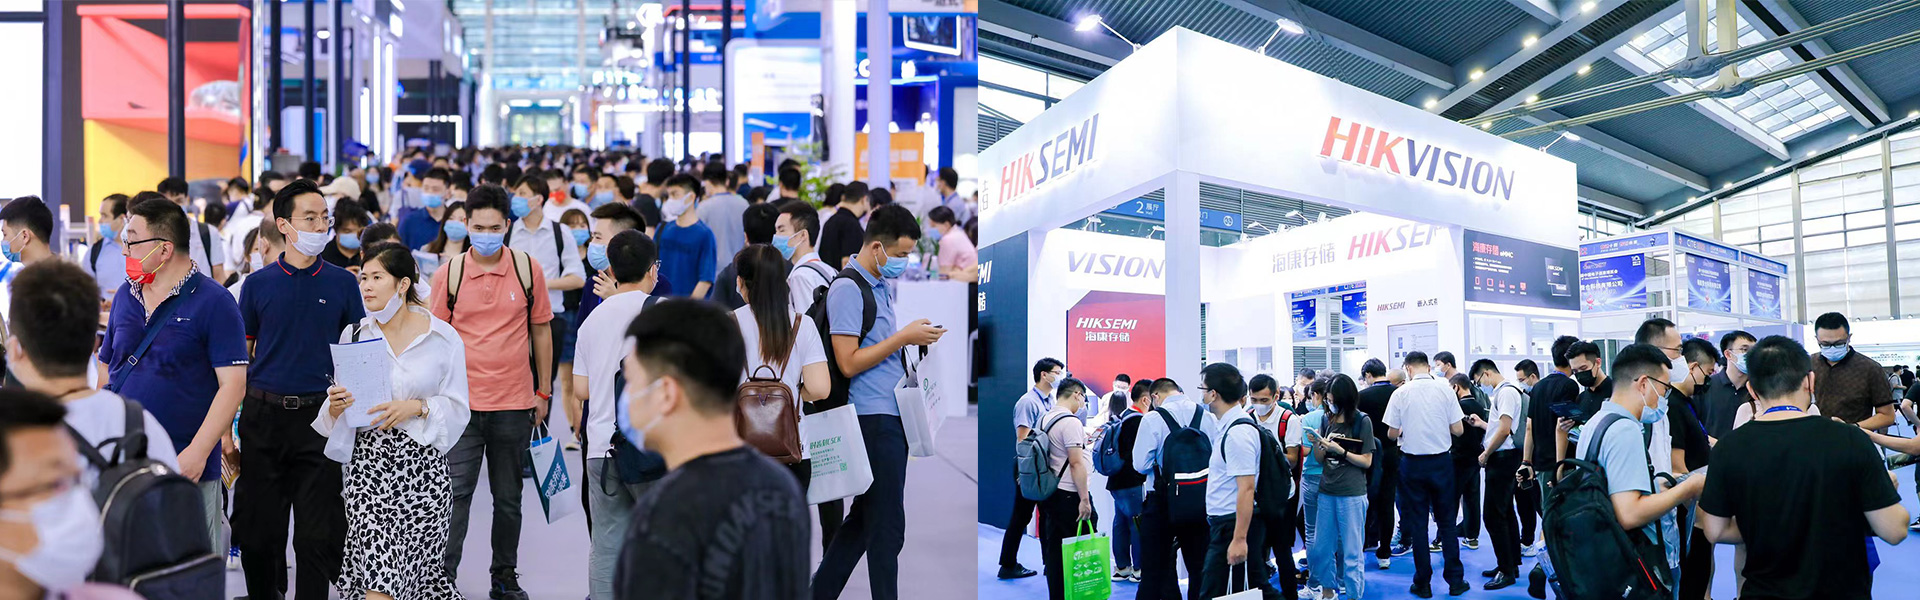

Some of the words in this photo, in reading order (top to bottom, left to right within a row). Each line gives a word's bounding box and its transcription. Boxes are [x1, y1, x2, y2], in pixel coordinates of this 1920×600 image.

[998, 113, 1099, 204] HIKSEMI
[1320, 116, 1515, 200] HIKVISION
[1136, 201, 1144, 214] 2
[1068, 251, 1165, 279] VISION
[1272, 243, 1335, 273] 海康存储
[1377, 301, 1406, 311] HIKSEMI
[1076, 317, 1138, 330] HIKSEMI
[1085, 331, 1130, 342] 海康存储
